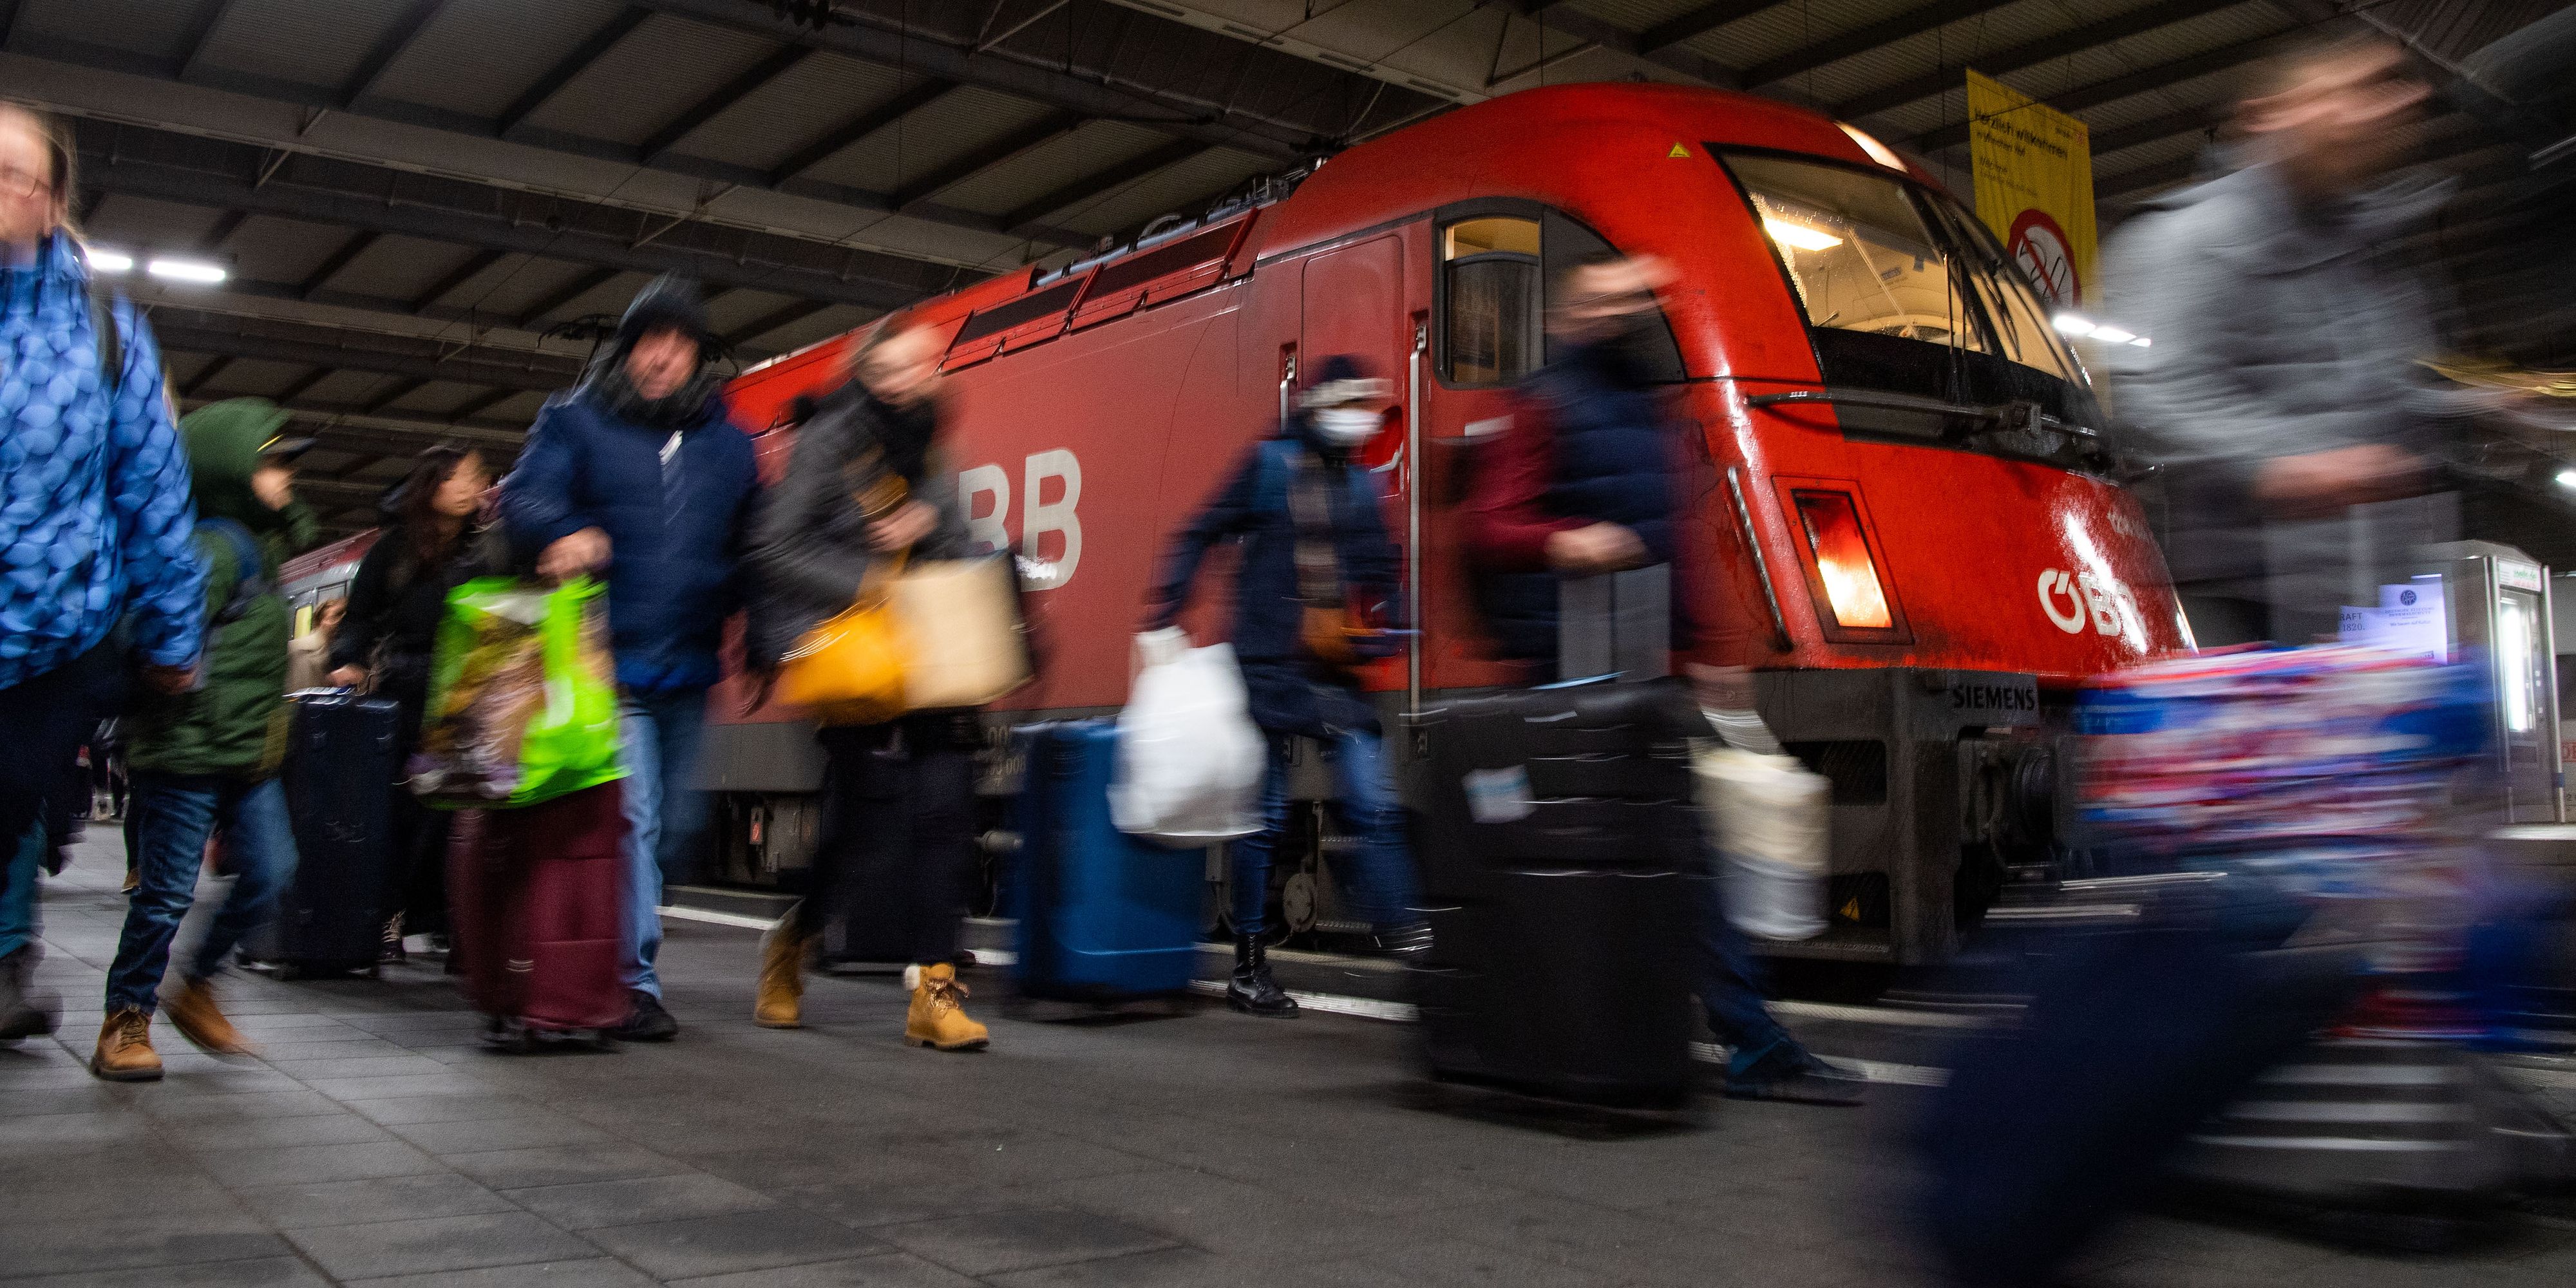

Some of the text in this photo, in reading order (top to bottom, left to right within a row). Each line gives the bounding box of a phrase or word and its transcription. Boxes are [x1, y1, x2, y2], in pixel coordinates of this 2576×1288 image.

[958, 448, 1082, 592] BB
[2037, 567, 2148, 645] ÖBB
[2340, 612, 2362, 621] RAFT
[2342, 623, 2365, 632] 1820.
[1953, 685, 2035, 711] SIEMENS
